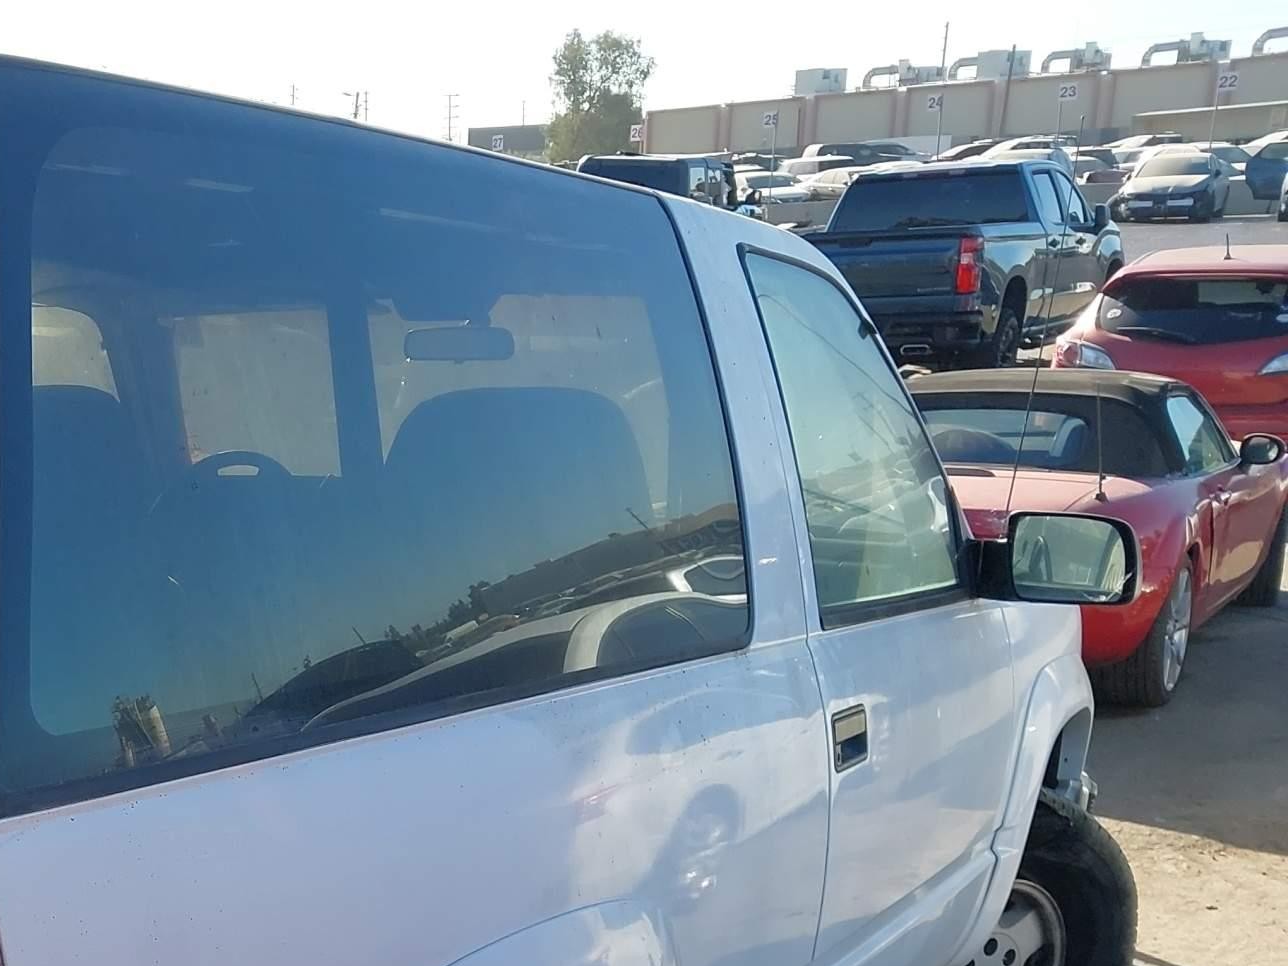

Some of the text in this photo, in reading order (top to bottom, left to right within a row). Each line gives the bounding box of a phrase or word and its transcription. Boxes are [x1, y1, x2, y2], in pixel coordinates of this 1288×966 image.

[1218, 75, 1238, 88] 22
[1059, 86, 1077, 98] 23
[928, 96, 943, 109] 24
[763, 114, 778, 126] 25
[493, 137, 503, 149] 27
